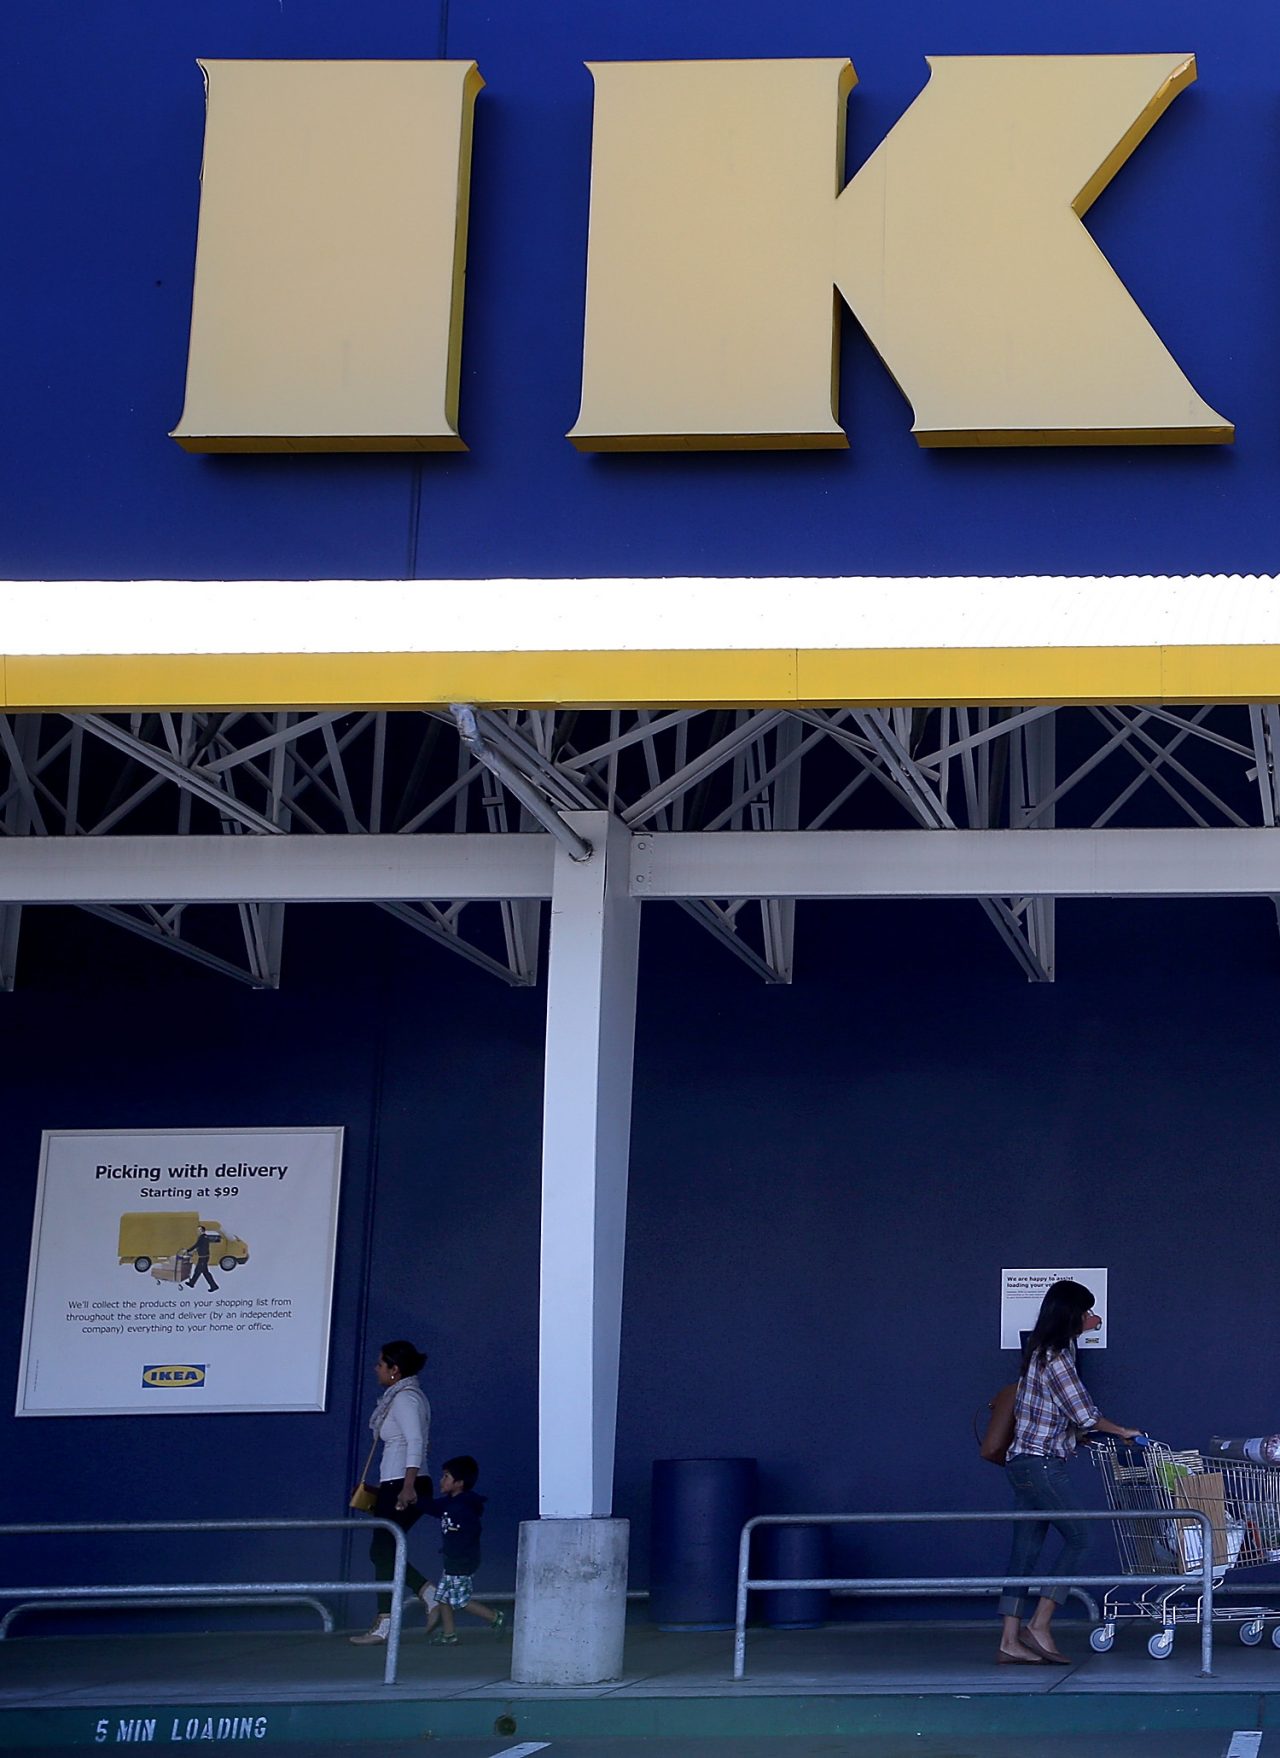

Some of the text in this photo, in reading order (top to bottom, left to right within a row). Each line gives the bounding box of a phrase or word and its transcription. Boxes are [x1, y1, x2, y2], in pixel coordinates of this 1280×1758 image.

[95, 1163, 288, 1182] Picking with delivery
[140, 1186, 239, 1199] Starting at $99
[68, 1298, 292, 1310] We'll collect the products on your shopping list from
[66, 1313, 115, 1322] throughout
[117, 1313, 132, 1321] the
[134, 1313, 156, 1321] store
[159, 1312, 176, 1320] and
[178, 1312, 207, 1320] deliver
[209, 1311, 223, 1321] (by
[240, 1310, 292, 1320] independent
[82, 1322, 274, 1335] company) everything to your home or office.
[151, 1371, 198, 1381] IKEA
[95, 1716, 267, 1742] 5 MIN LOADING
